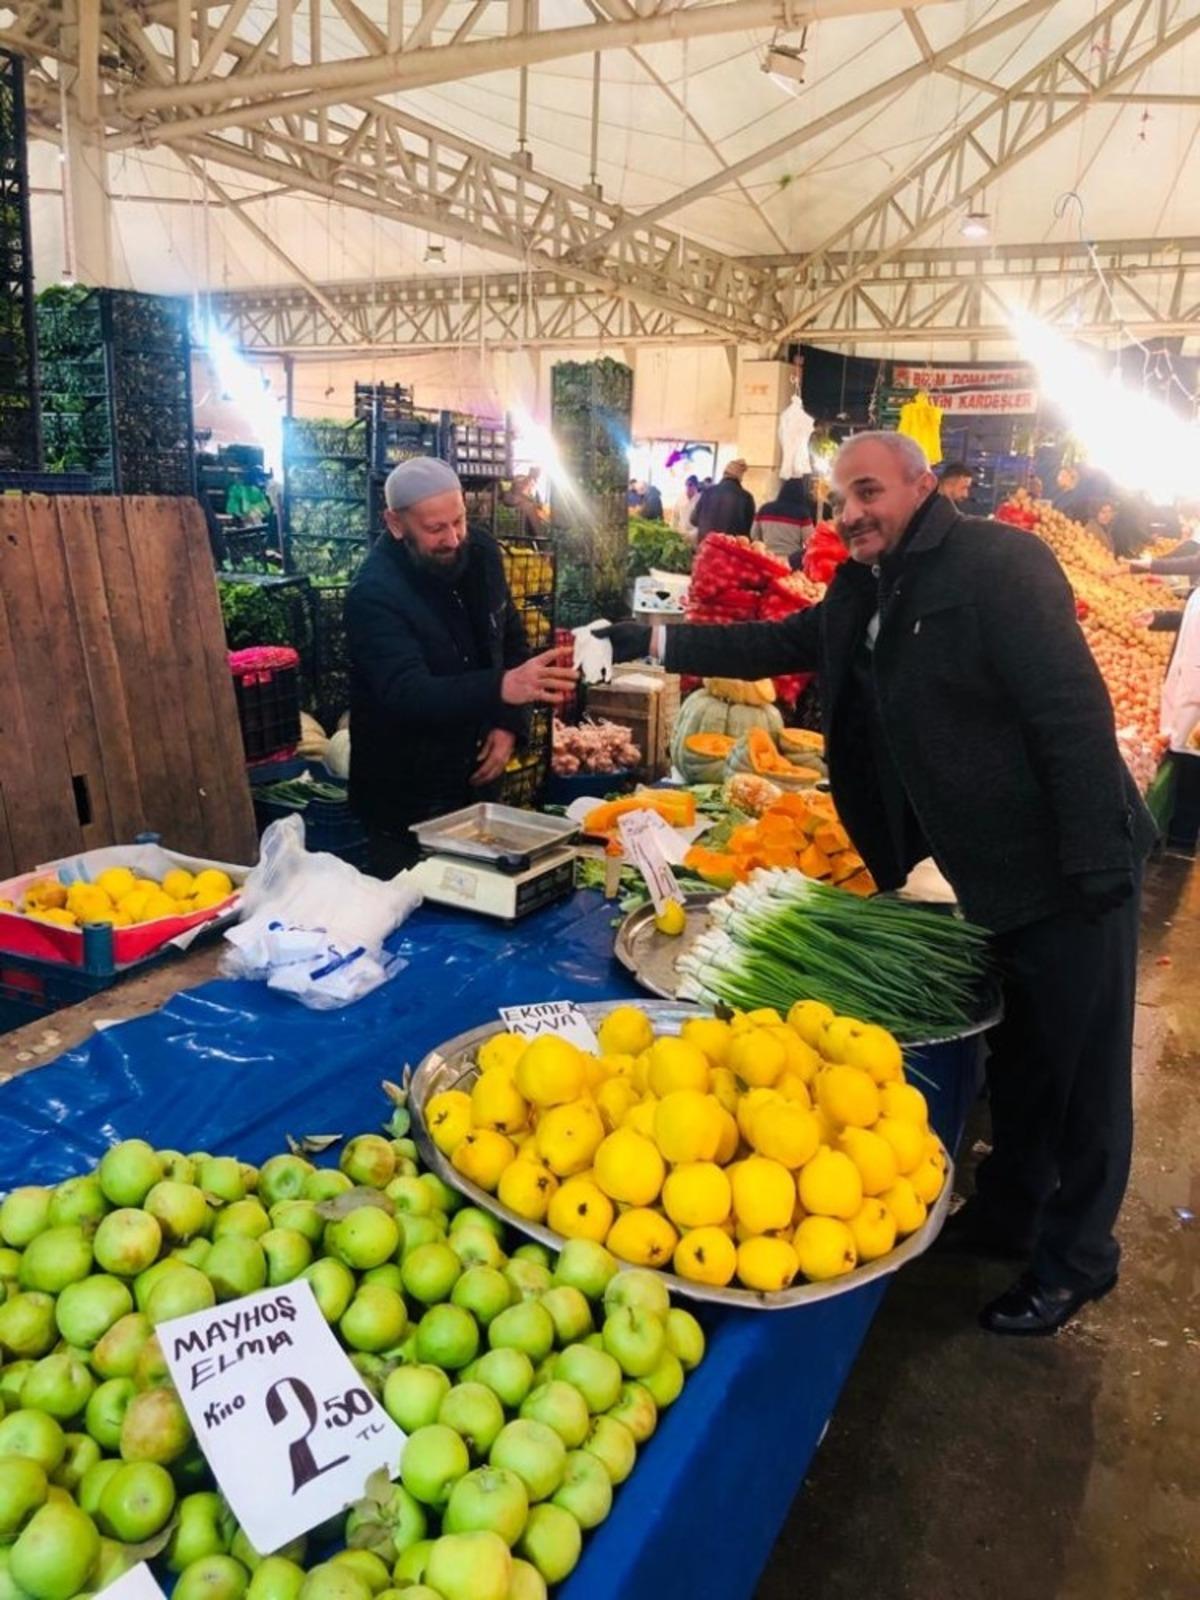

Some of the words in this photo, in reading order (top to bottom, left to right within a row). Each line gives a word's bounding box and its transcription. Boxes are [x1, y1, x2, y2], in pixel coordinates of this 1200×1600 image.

[503, 1002, 583, 1022] EKMEK
[513, 1013, 576, 1035] AYVA
[173, 1295, 297, 1362] MAYHOŞ
[190, 1329, 294, 1391] ELMA
[355, 1421, 386, 1442] TL
